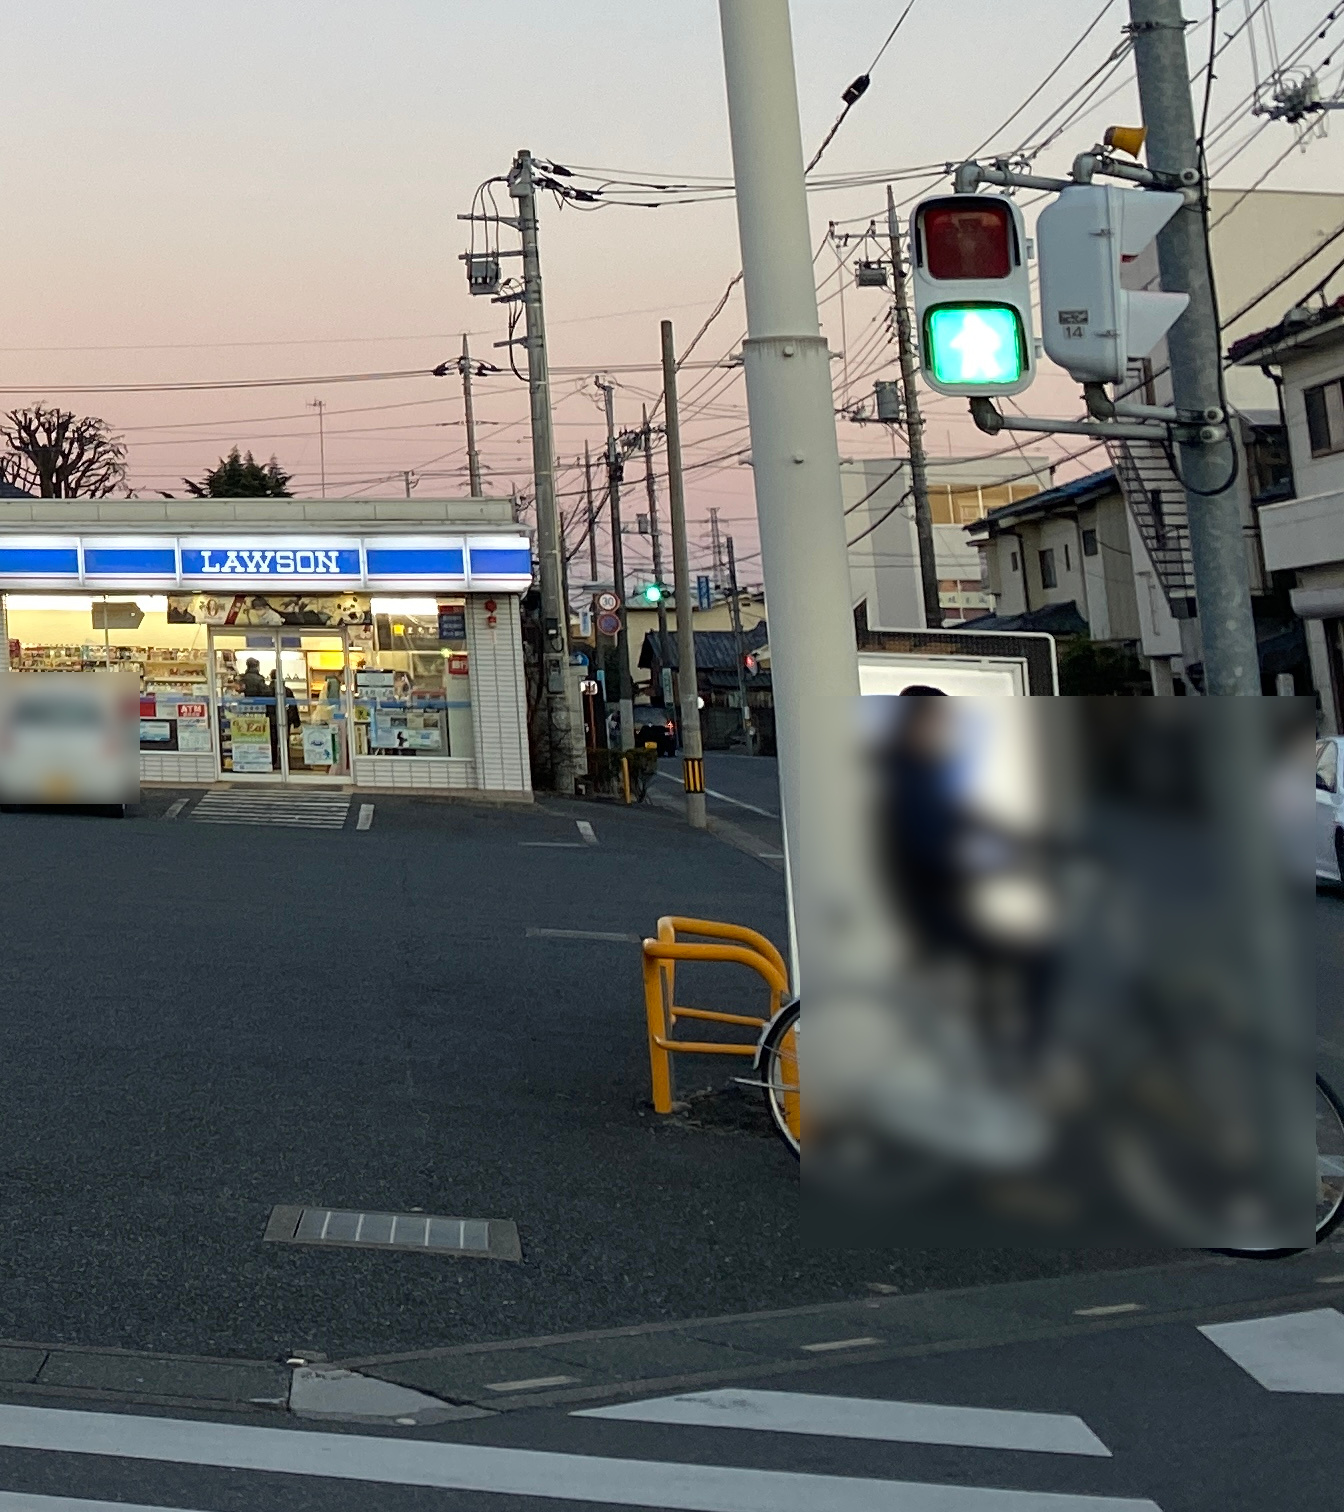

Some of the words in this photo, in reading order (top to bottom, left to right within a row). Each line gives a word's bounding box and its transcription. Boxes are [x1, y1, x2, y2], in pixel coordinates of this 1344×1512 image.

[1065, 326, 1083, 339] 14
[200, 550, 341, 574] LAWSON
[601, 596, 614, 607] 30
[180, 704, 202, 714] ATM
